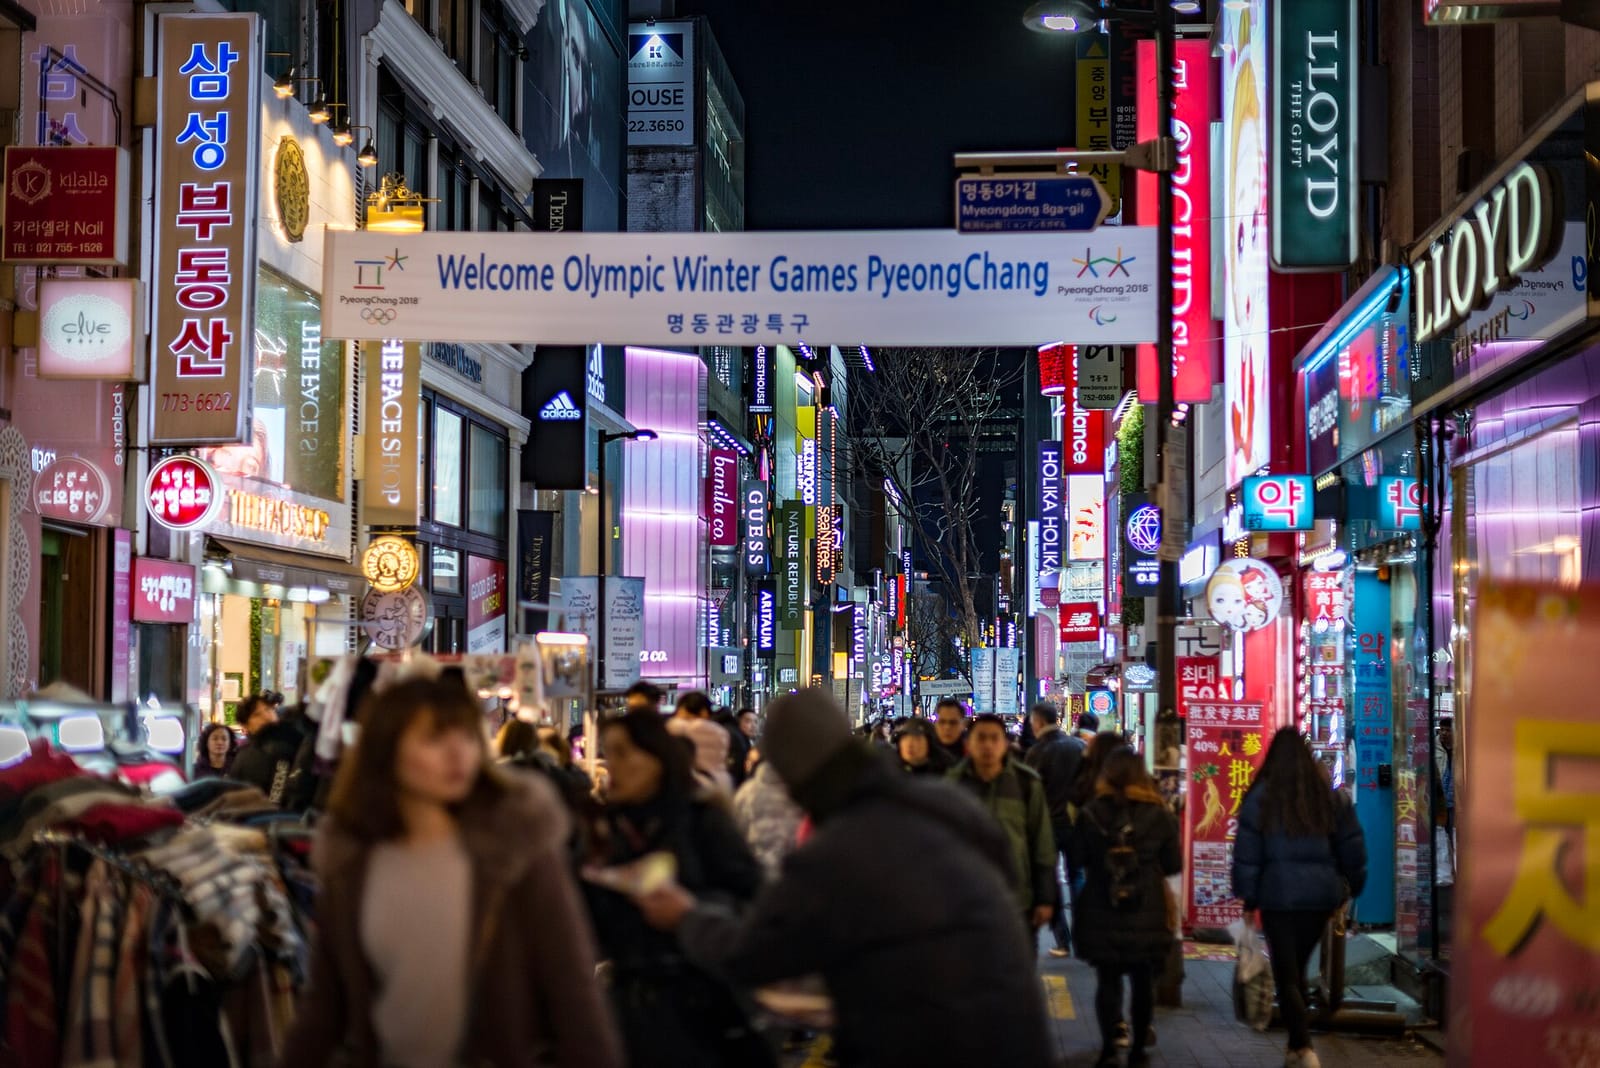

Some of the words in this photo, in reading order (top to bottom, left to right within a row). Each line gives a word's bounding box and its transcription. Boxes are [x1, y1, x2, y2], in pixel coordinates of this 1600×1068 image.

[628, 88, 684, 106] OUSE
[1291, 80, 1302, 118] THE
[1307, 30, 1339, 217] LLOYD
[1291, 123, 1302, 167] GIFT
[169, 41, 239, 377] 삼성부동산
[962, 181, 1036, 200] 명동8가길
[962, 204, 1040, 217] Myeongdong
[1042, 203, 1084, 216] 8ga-gil
[13, 220, 70, 237] 키라엘라
[74, 221, 103, 236] Nail
[13, 242, 26, 253] TEL
[1413, 160, 1542, 341] LLOYD
[437, 252, 554, 291] Welcome
[563, 255, 665, 298] Olympic
[673, 254, 760, 293] Winter
[770, 255, 857, 293] Games
[867, 251, 1049, 299] PyeongChang
[1058, 284, 1124, 296] PyeongChang
[1125, 285, 1149, 293] 2018
[340, 295, 398, 306] PyeongChang
[399, 296, 419, 305] 2018
[61, 311, 111, 337] clue
[668, 313, 810, 334] 명동관광특구
[382, 340, 403, 372] HE
[162, 392, 232, 412] 773-6622
[381, 373, 403, 433] FACE
[541, 408, 581, 420] adidas
[381, 438, 402, 505] SHOP
[713, 456, 735, 515] banila
[803, 438, 815, 505] SKINFOOD
[1043, 451, 1058, 512] HOLIKA
[1257, 479, 1305, 527] 약
[713, 522, 734, 541] co.
[748, 490, 764, 566] GUESS
[788, 510, 799, 559] NATURE
[1043, 517, 1058, 577] HOLIKA
[788, 562, 799, 619] REPUBLIC
[761, 591, 772, 648] ARITAUM
[854, 607, 864, 663] KLAVUU
[872, 662, 882, 692] OMM
[1182, 664, 1215, 684] 최대
[1189, 706, 1260, 721] 批发专卖店
